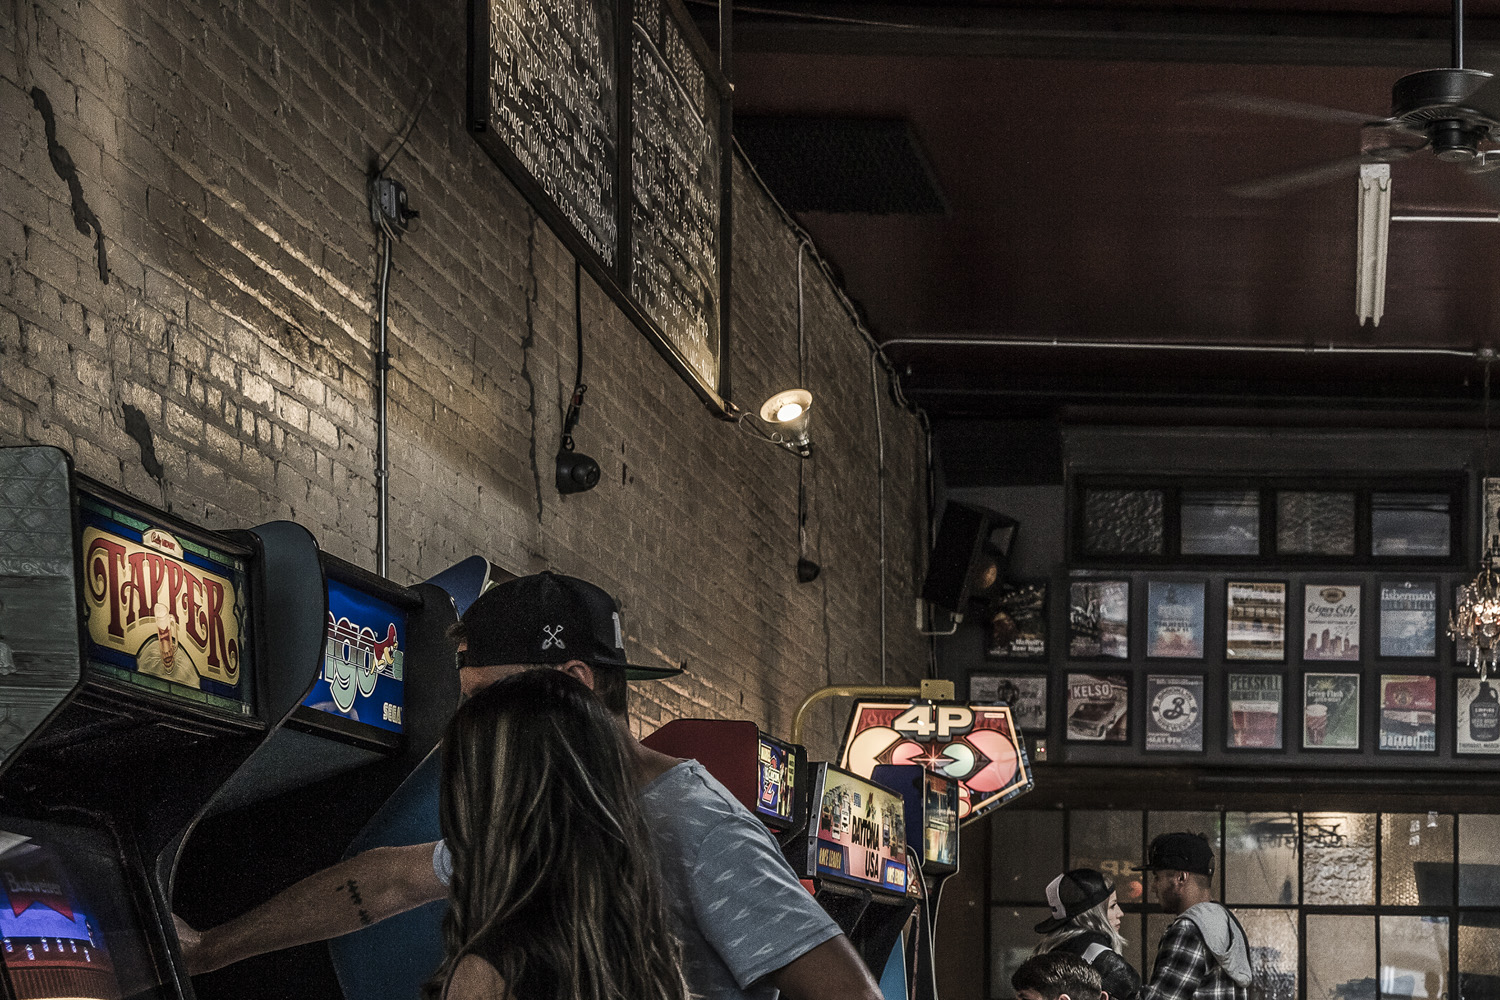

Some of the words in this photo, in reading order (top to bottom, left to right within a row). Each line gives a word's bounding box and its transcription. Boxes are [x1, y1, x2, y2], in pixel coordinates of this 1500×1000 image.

[87, 538, 239, 674] TAPPER
[1382, 589, 1436, 601] fisherman's
[1073, 684, 1111, 697] KELSO
[1230, 675, 1281, 690] PEEKSKILL
[382, 702, 402, 725] SEGA
[893, 705, 973, 737] 4P
[852, 815, 880, 851] DAYTONA
[865, 851, 879, 879] USA
